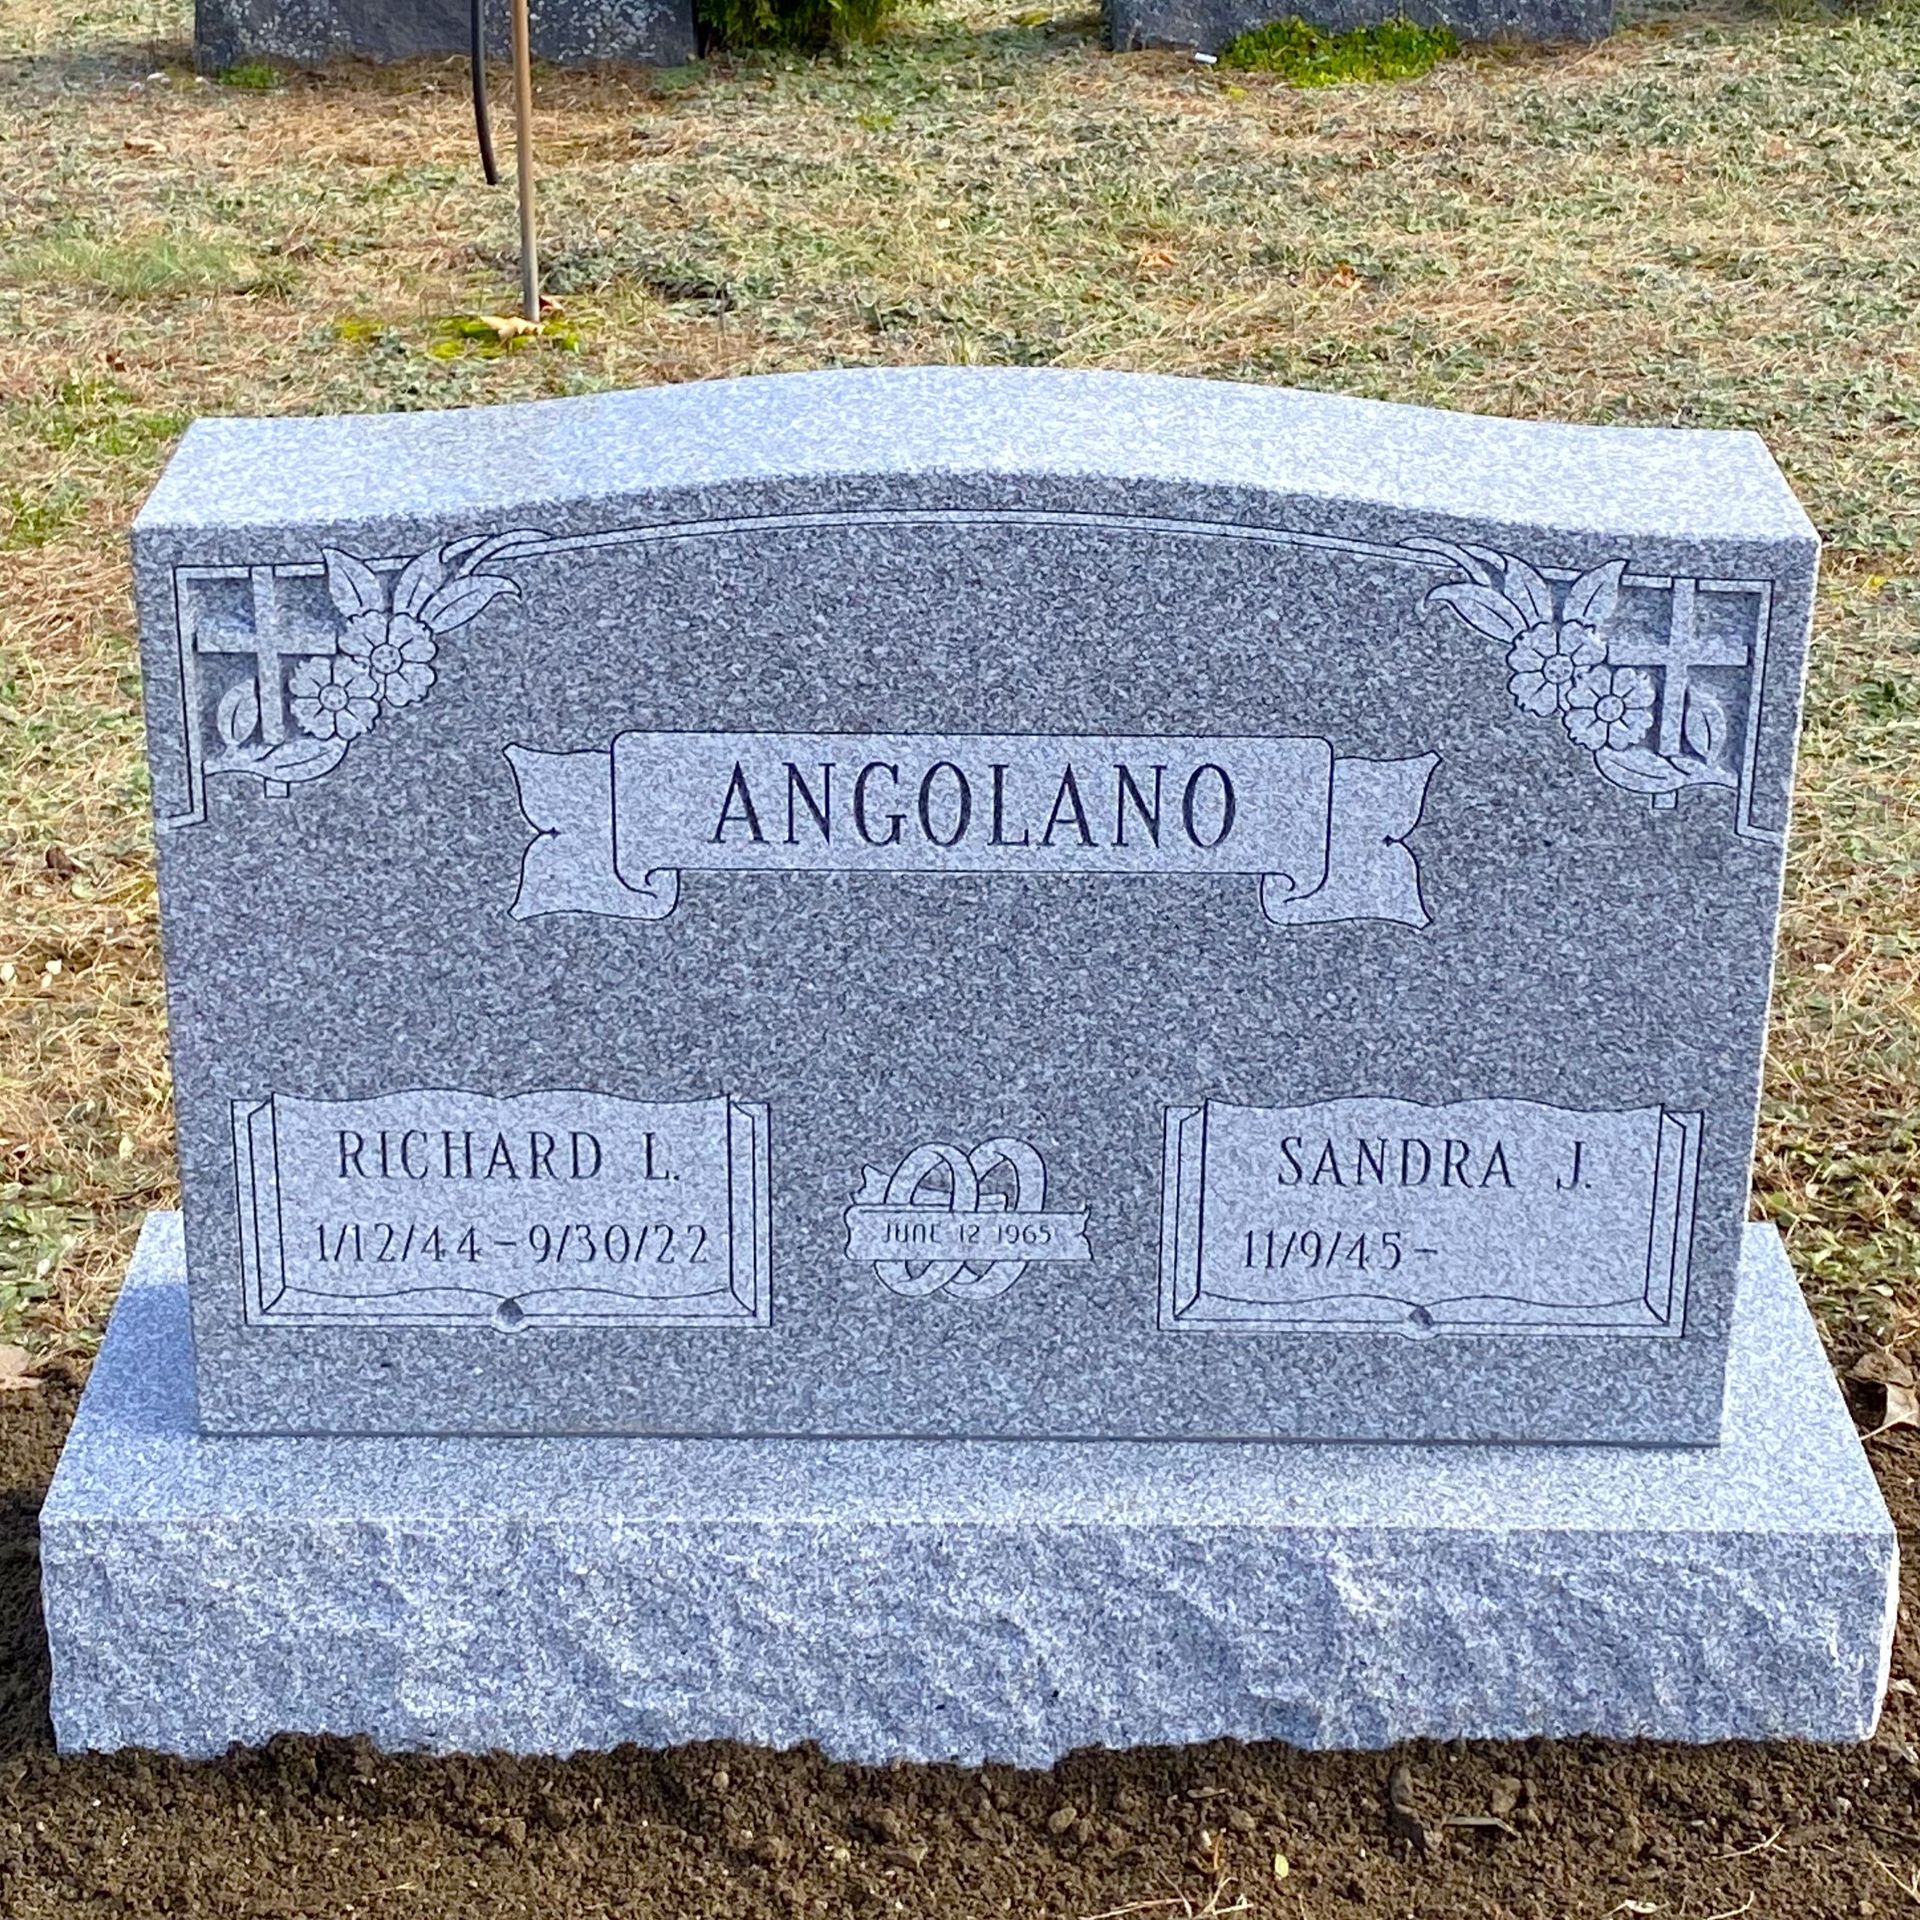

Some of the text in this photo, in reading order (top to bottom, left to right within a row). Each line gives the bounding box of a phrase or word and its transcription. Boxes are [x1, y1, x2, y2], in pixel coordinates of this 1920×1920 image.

[707, 759, 1238, 849] ANGOLANO
[338, 1129, 682, 1182] RICHARD L.
[1277, 1136, 1593, 1191] SANDRA J.
[882, 1223, 1052, 1245] JUNE 12 1965
